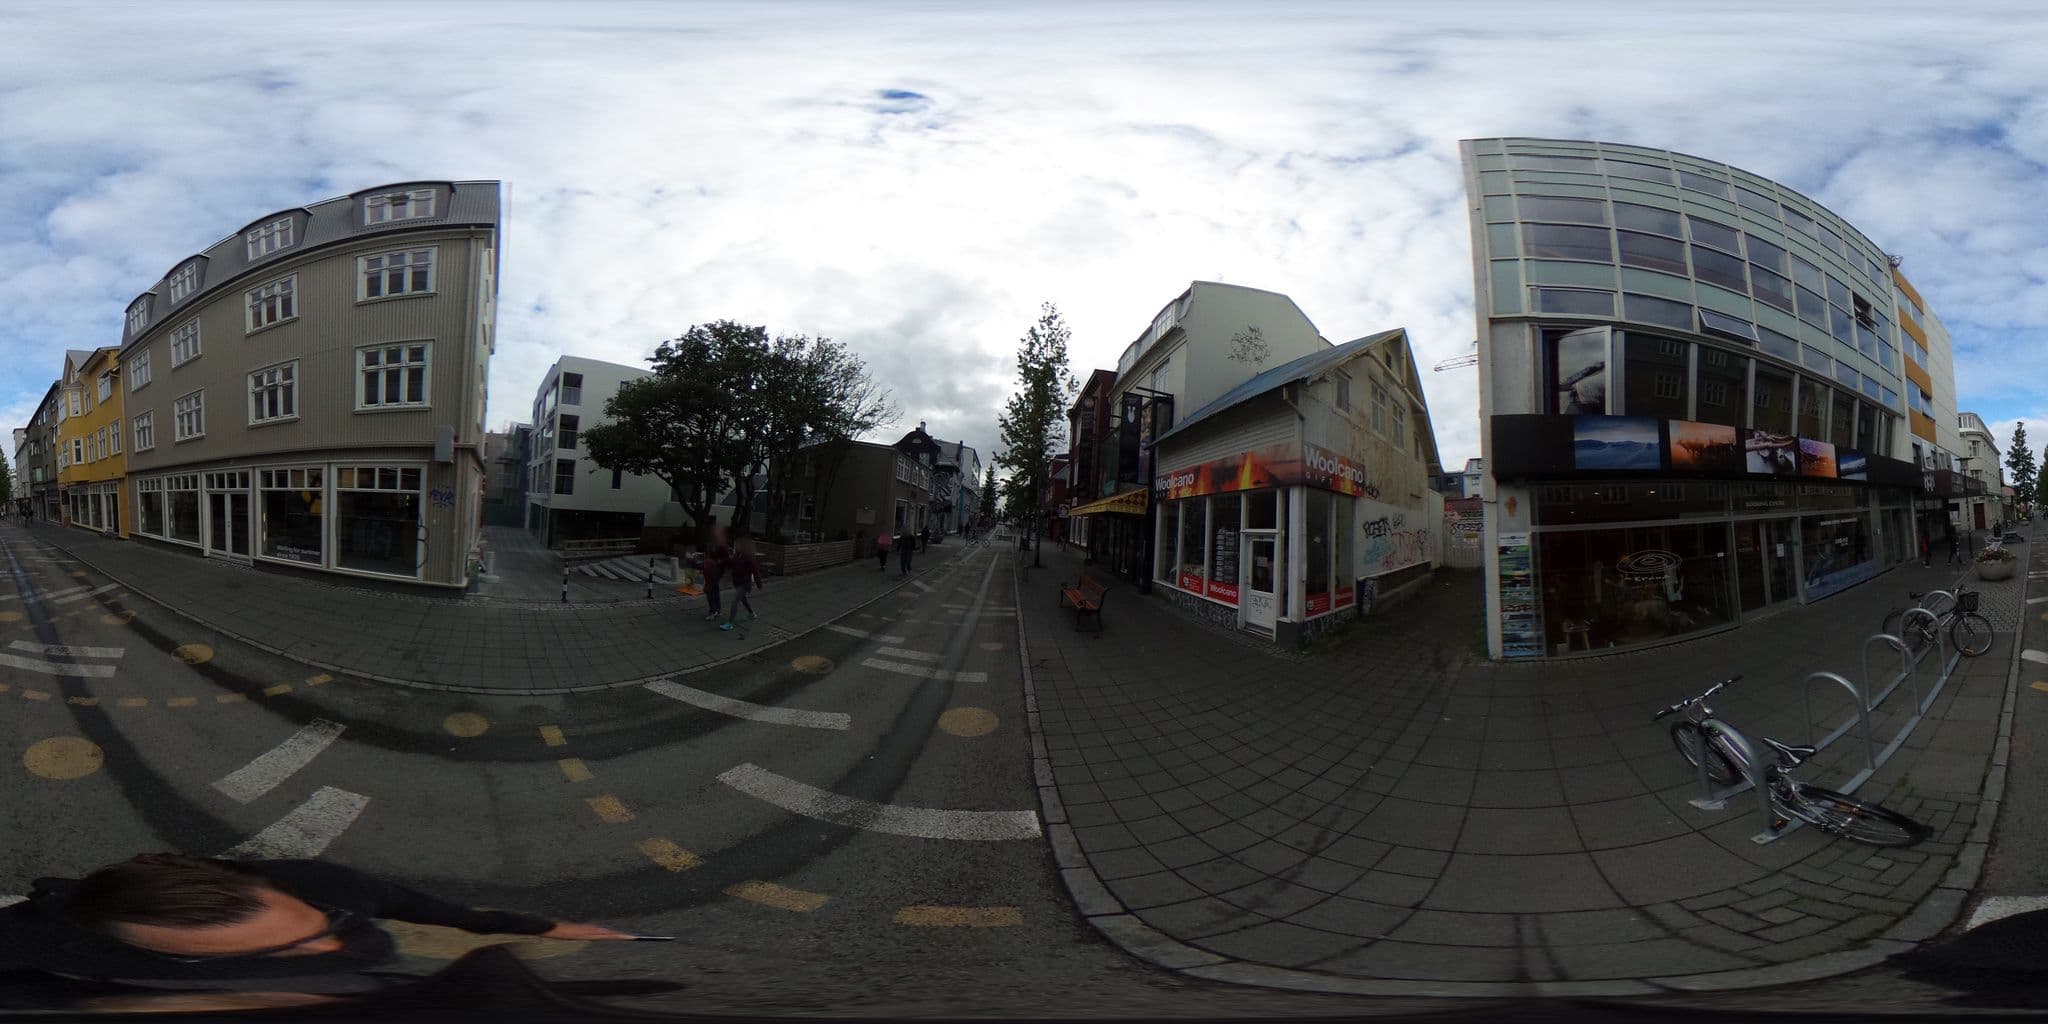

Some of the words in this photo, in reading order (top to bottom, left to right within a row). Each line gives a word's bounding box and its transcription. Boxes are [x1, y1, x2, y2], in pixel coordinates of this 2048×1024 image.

[1303, 445, 1364, 484] Woolcano
[1155, 473, 1195, 491] Woolcano
[1209, 584, 1237, 598] Woolcano
